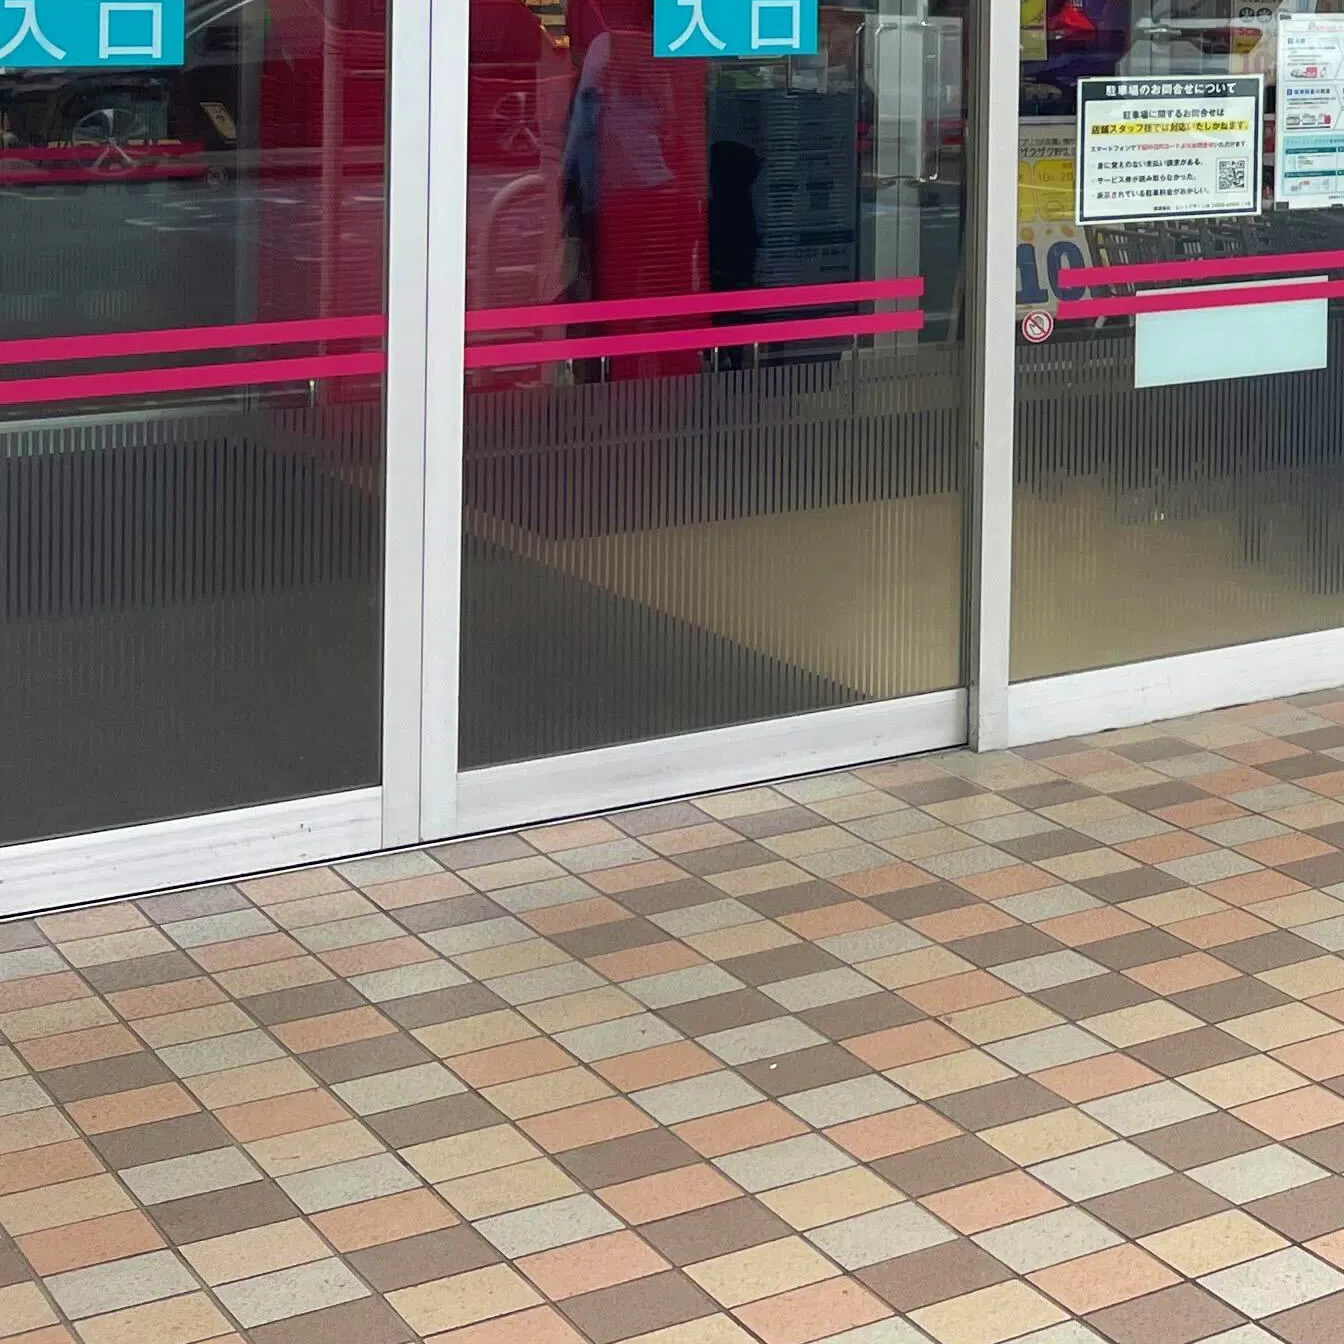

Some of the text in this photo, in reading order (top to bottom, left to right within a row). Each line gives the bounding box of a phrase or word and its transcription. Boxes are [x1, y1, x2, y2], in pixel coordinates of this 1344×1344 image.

[0, 0, 162, 60] 入口
[1106, 82, 1237, 96] 駐車場のお問合せについて
